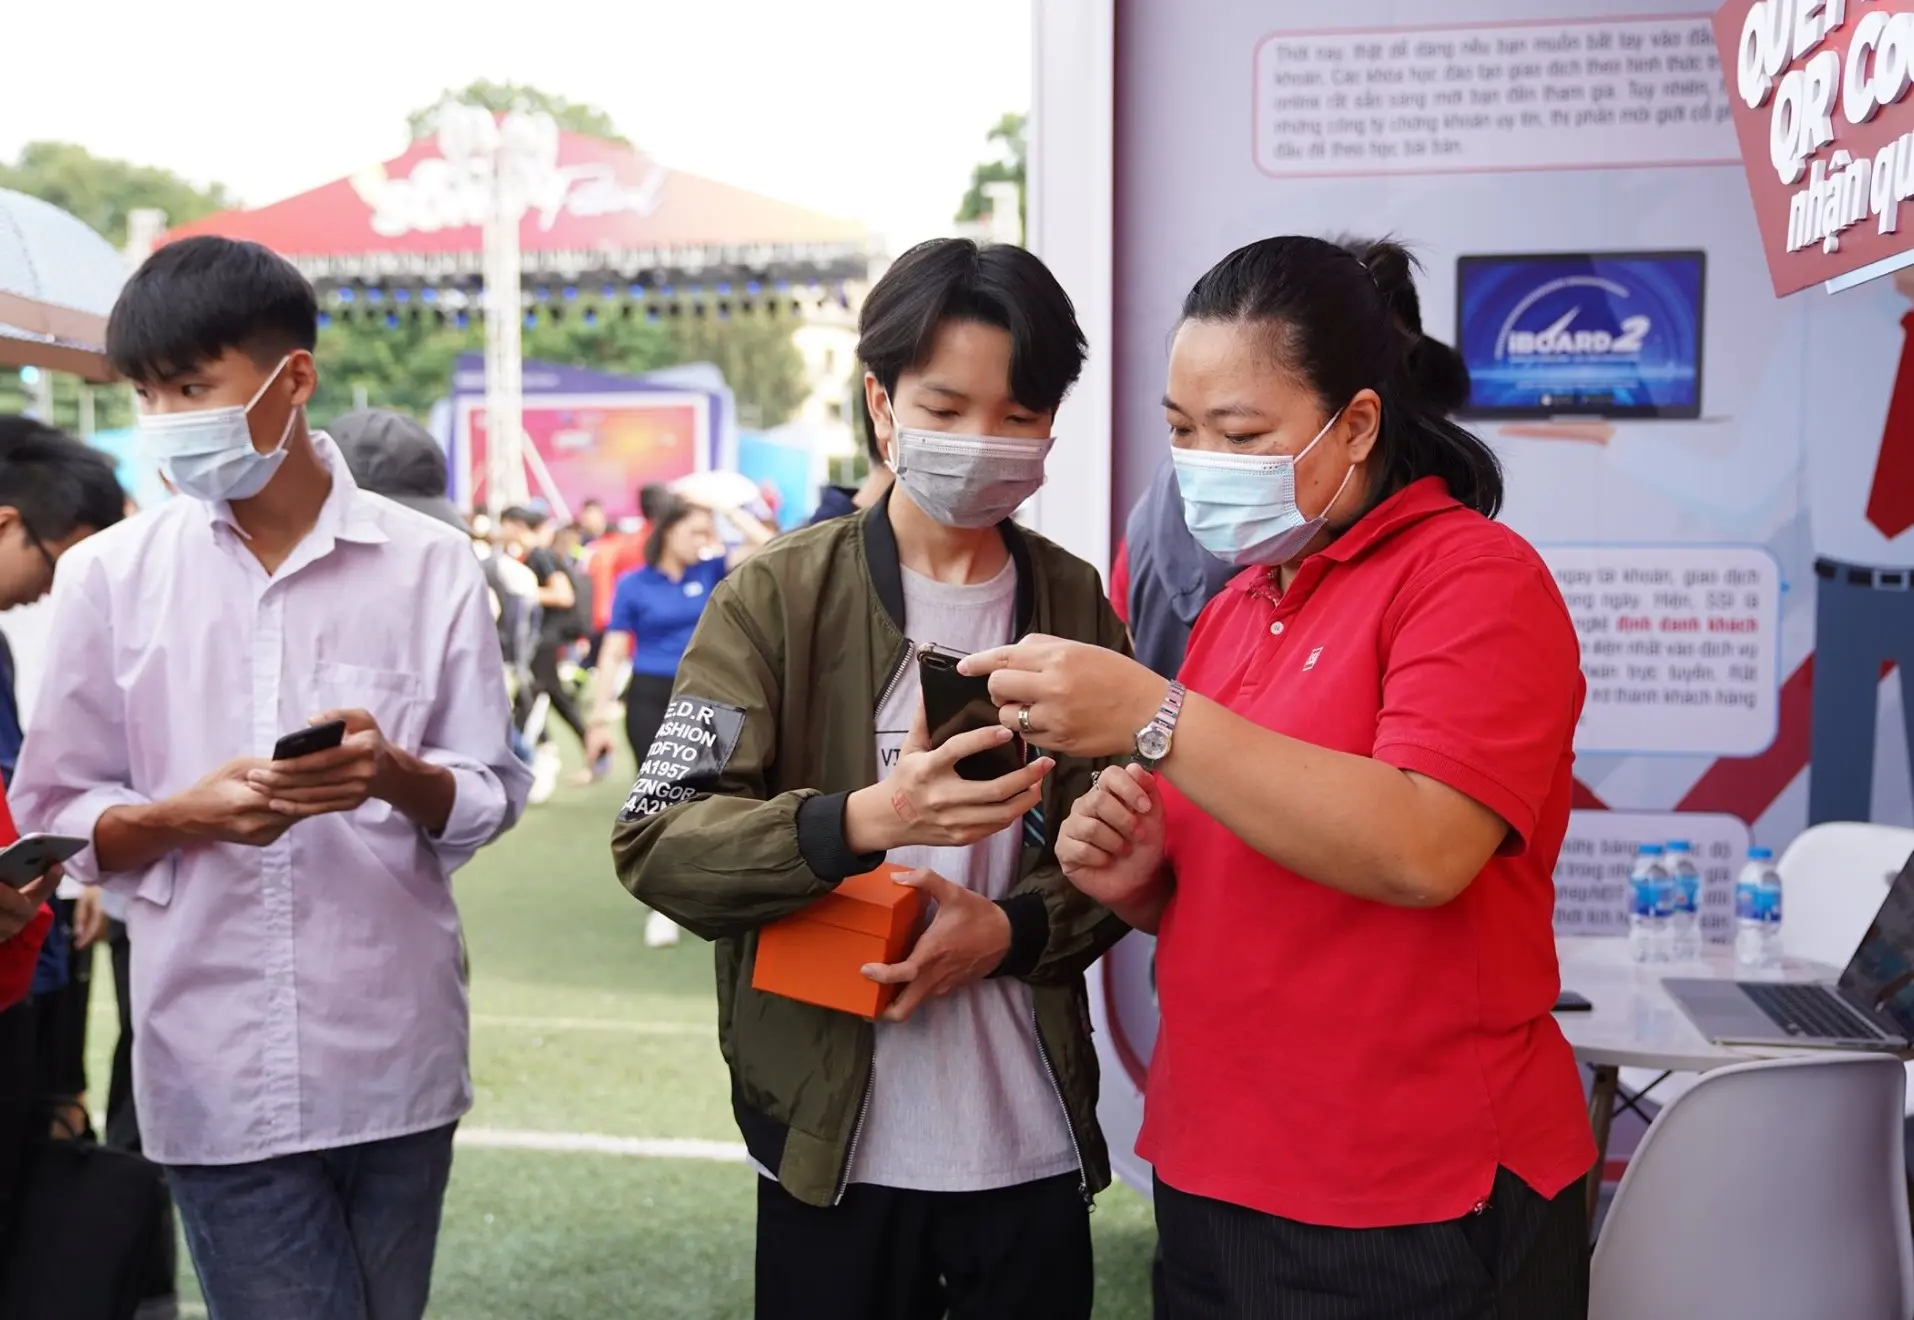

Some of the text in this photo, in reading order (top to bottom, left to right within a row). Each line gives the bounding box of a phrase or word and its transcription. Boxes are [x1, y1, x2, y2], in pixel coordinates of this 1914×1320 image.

[1770, 11, 1914, 185] QR CO
[1786, 150, 1872, 254] nhận
